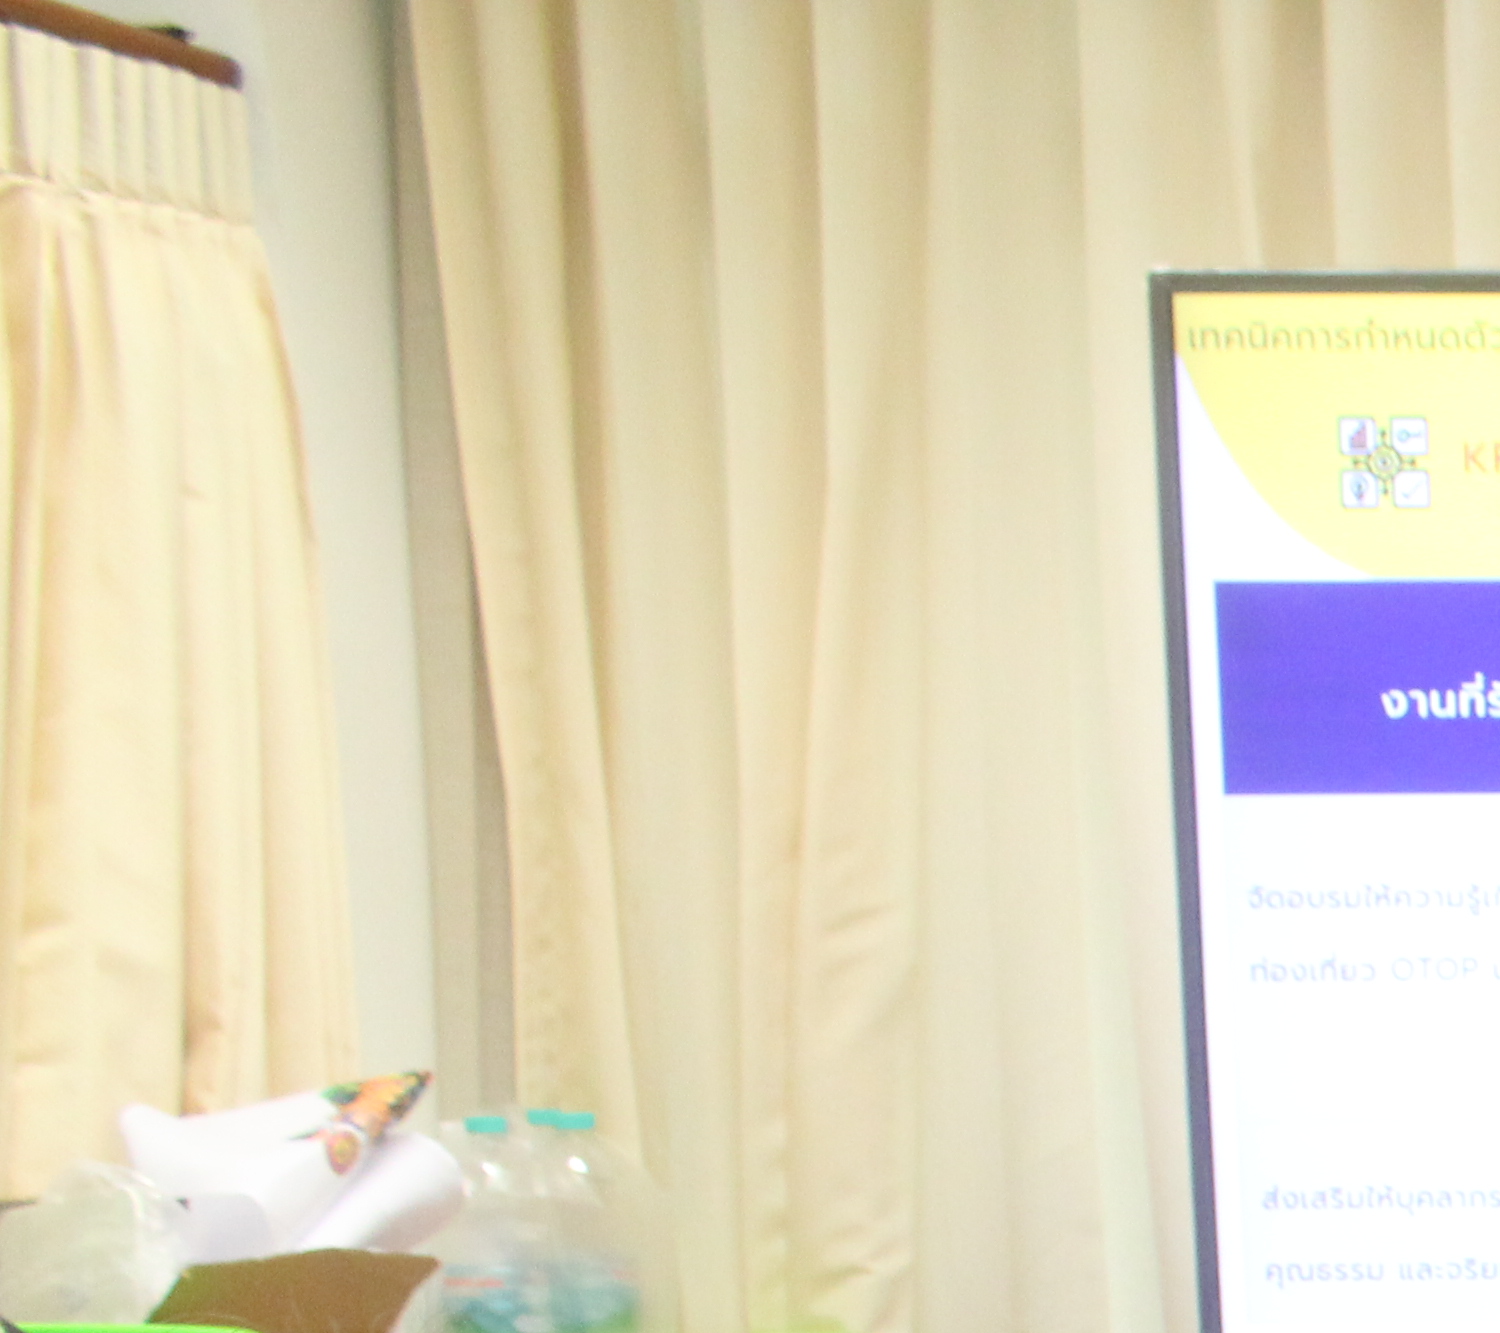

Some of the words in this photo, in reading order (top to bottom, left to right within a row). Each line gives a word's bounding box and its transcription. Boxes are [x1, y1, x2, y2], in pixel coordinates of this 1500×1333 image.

[1247, 953, 1378, 986] ท่องเที่ยว
[1389, 955, 1480, 983] OTOP
[1264, 1255, 1386, 1293] คุณธรรม
